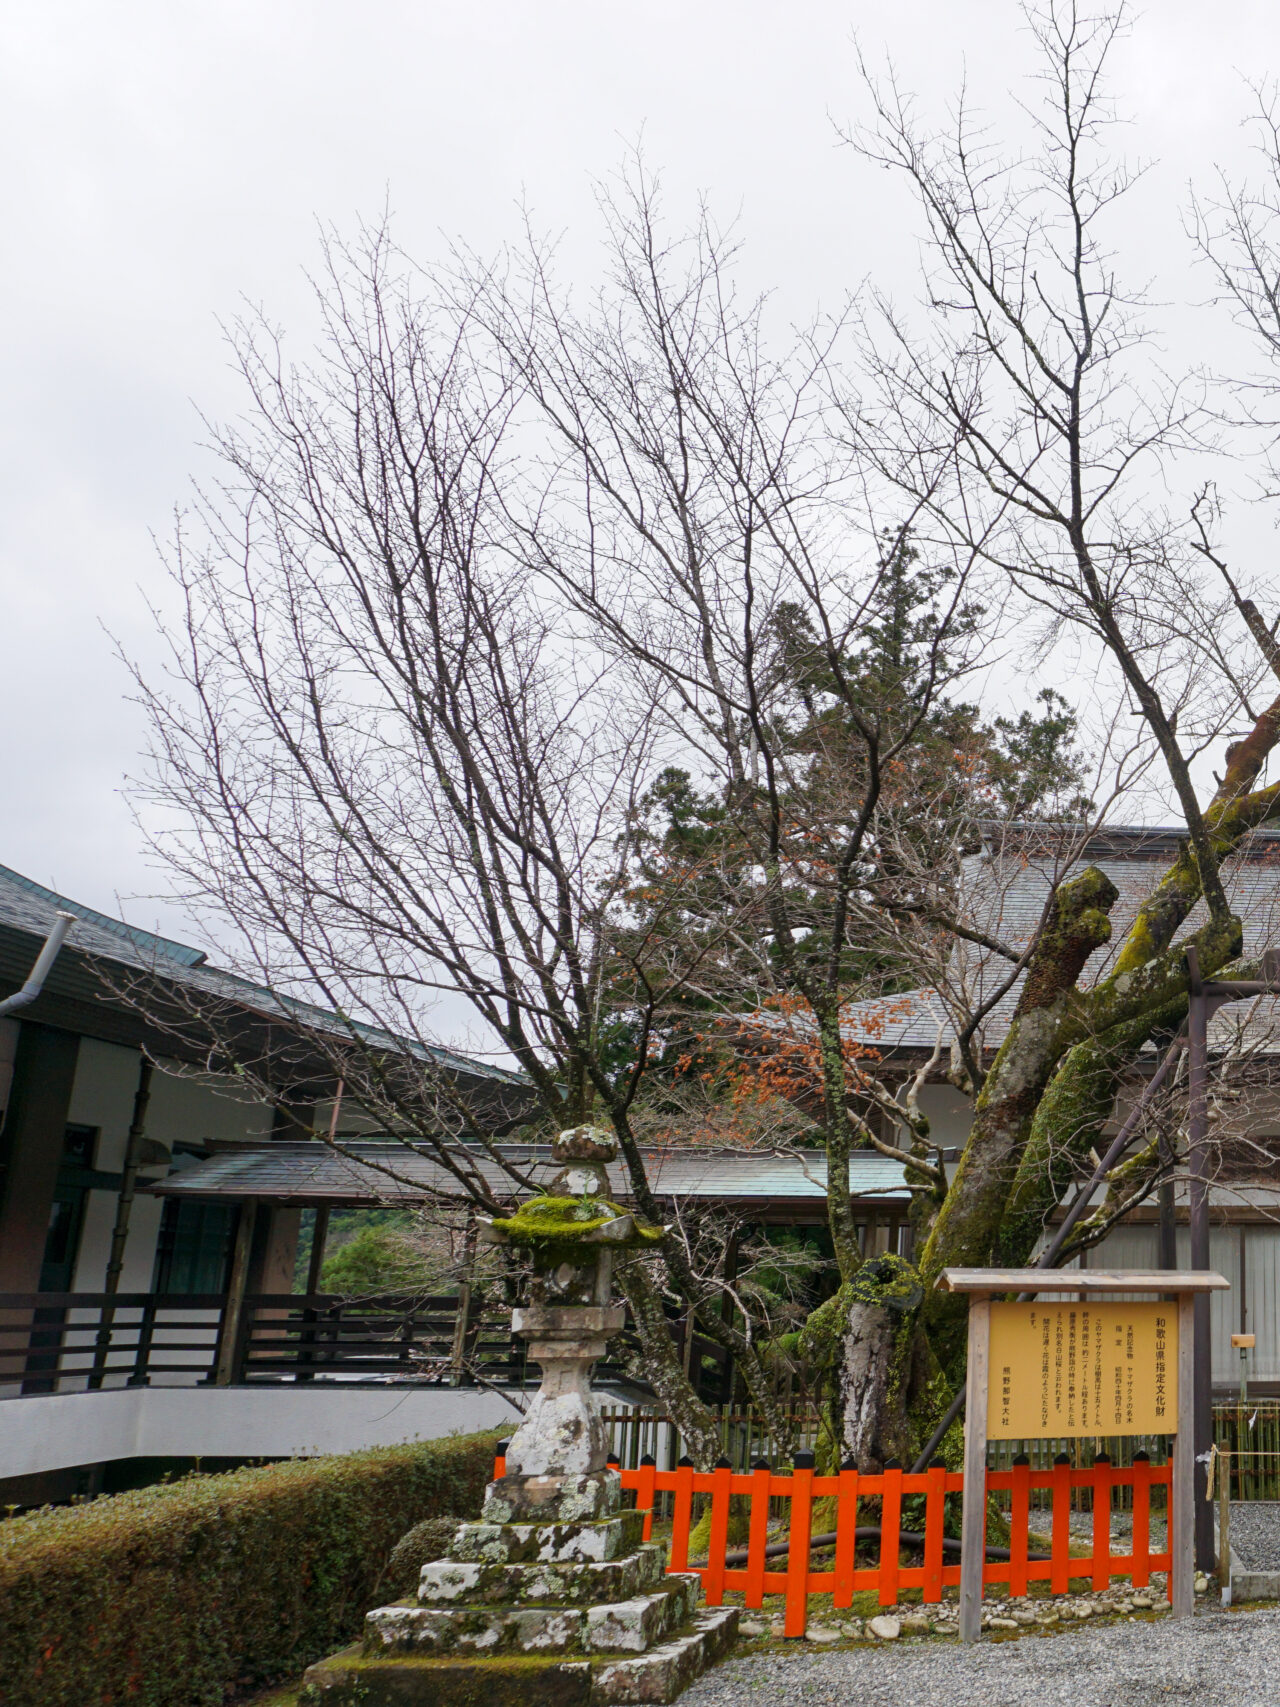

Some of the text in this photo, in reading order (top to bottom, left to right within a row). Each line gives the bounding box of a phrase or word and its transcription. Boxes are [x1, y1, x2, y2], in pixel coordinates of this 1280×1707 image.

[1126, 1324, 1134, 1359] 天然記念物
[1155, 1317, 1166, 1417] 和歌山県指定文化財
[1001, 1367, 1011, 1426] 熊野那智大社
